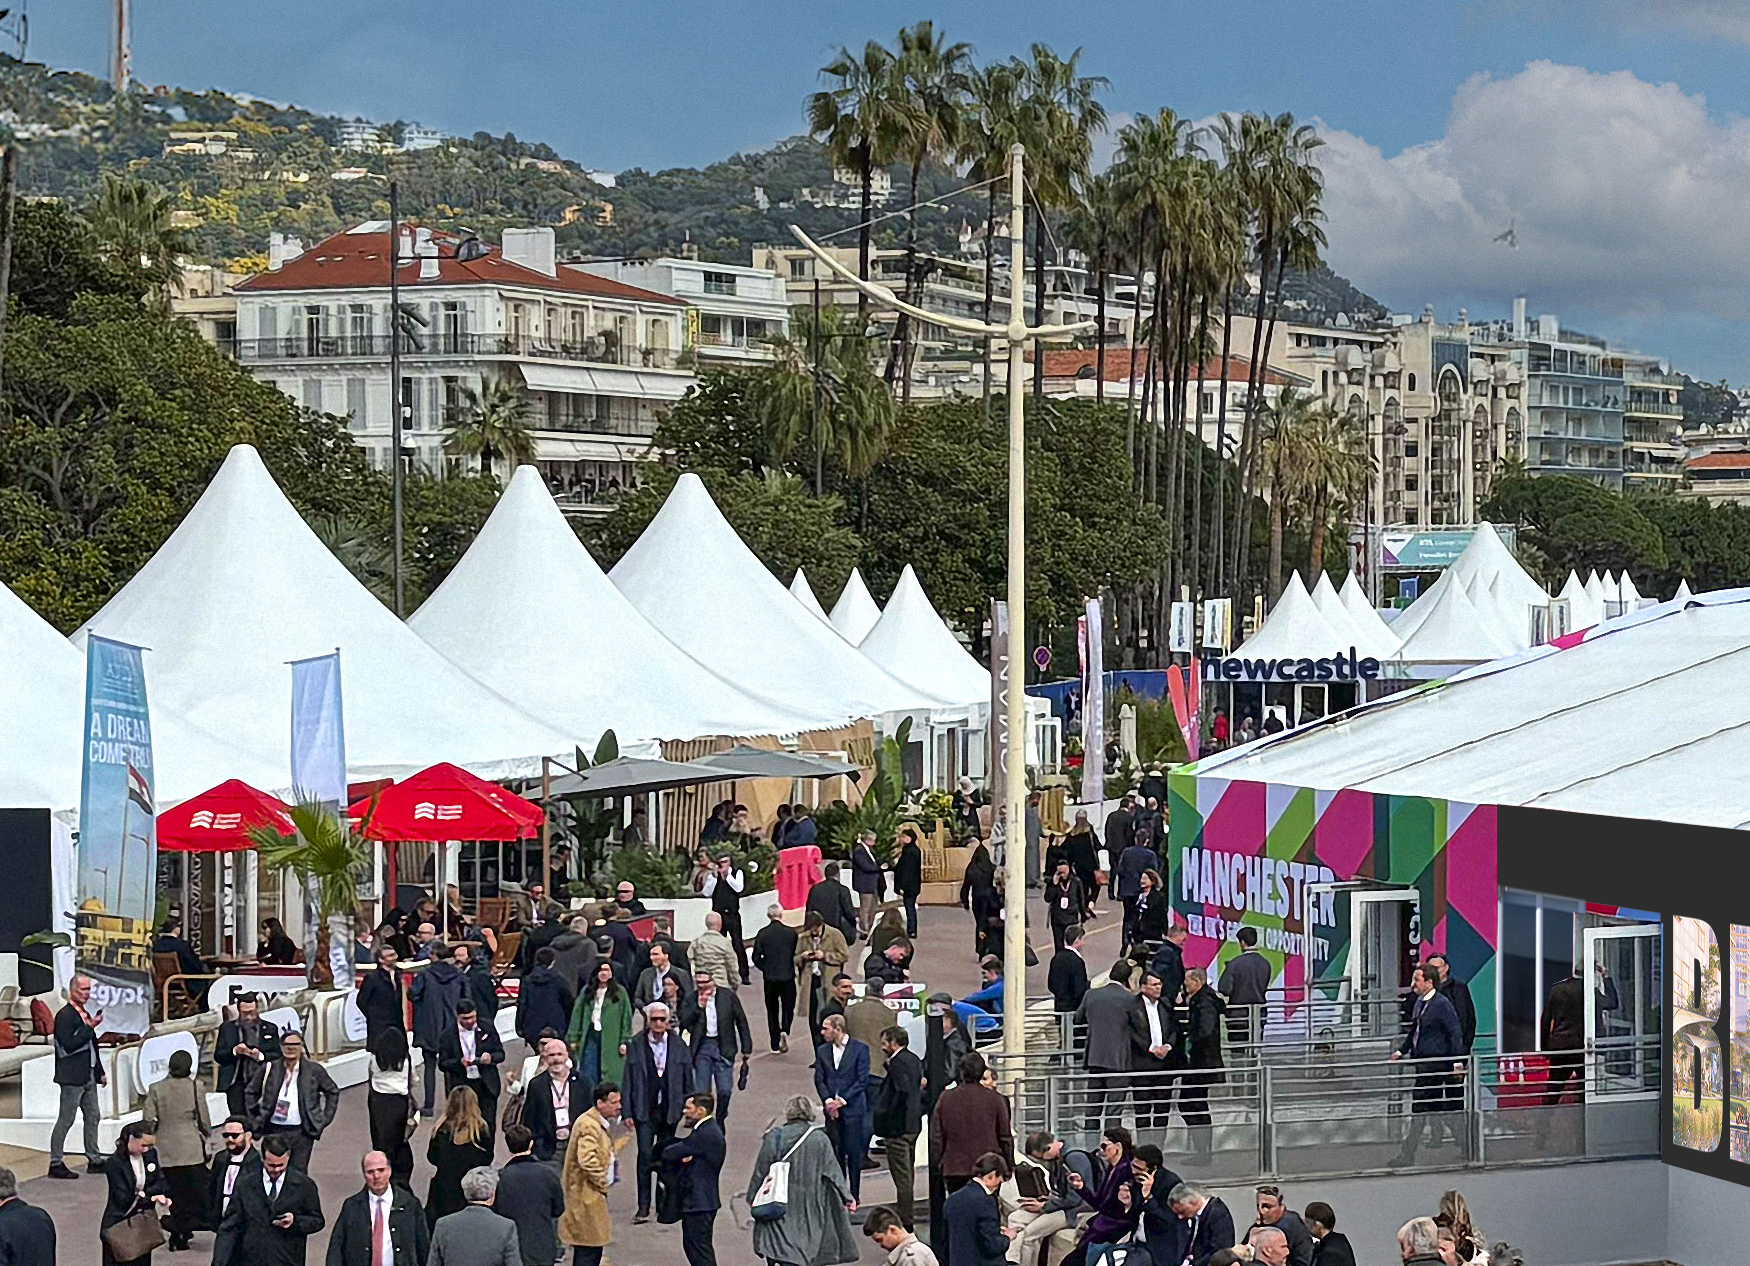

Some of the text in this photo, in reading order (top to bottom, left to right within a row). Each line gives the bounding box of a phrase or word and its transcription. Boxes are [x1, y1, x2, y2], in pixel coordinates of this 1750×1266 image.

[1201, 646, 1380, 681] newcastle
[90, 712, 102, 738] A
[89, 740, 127, 765] COME
[1182, 846, 1336, 928] MANCHESTER
[1265, 927, 1330, 963] OPPORTITY
